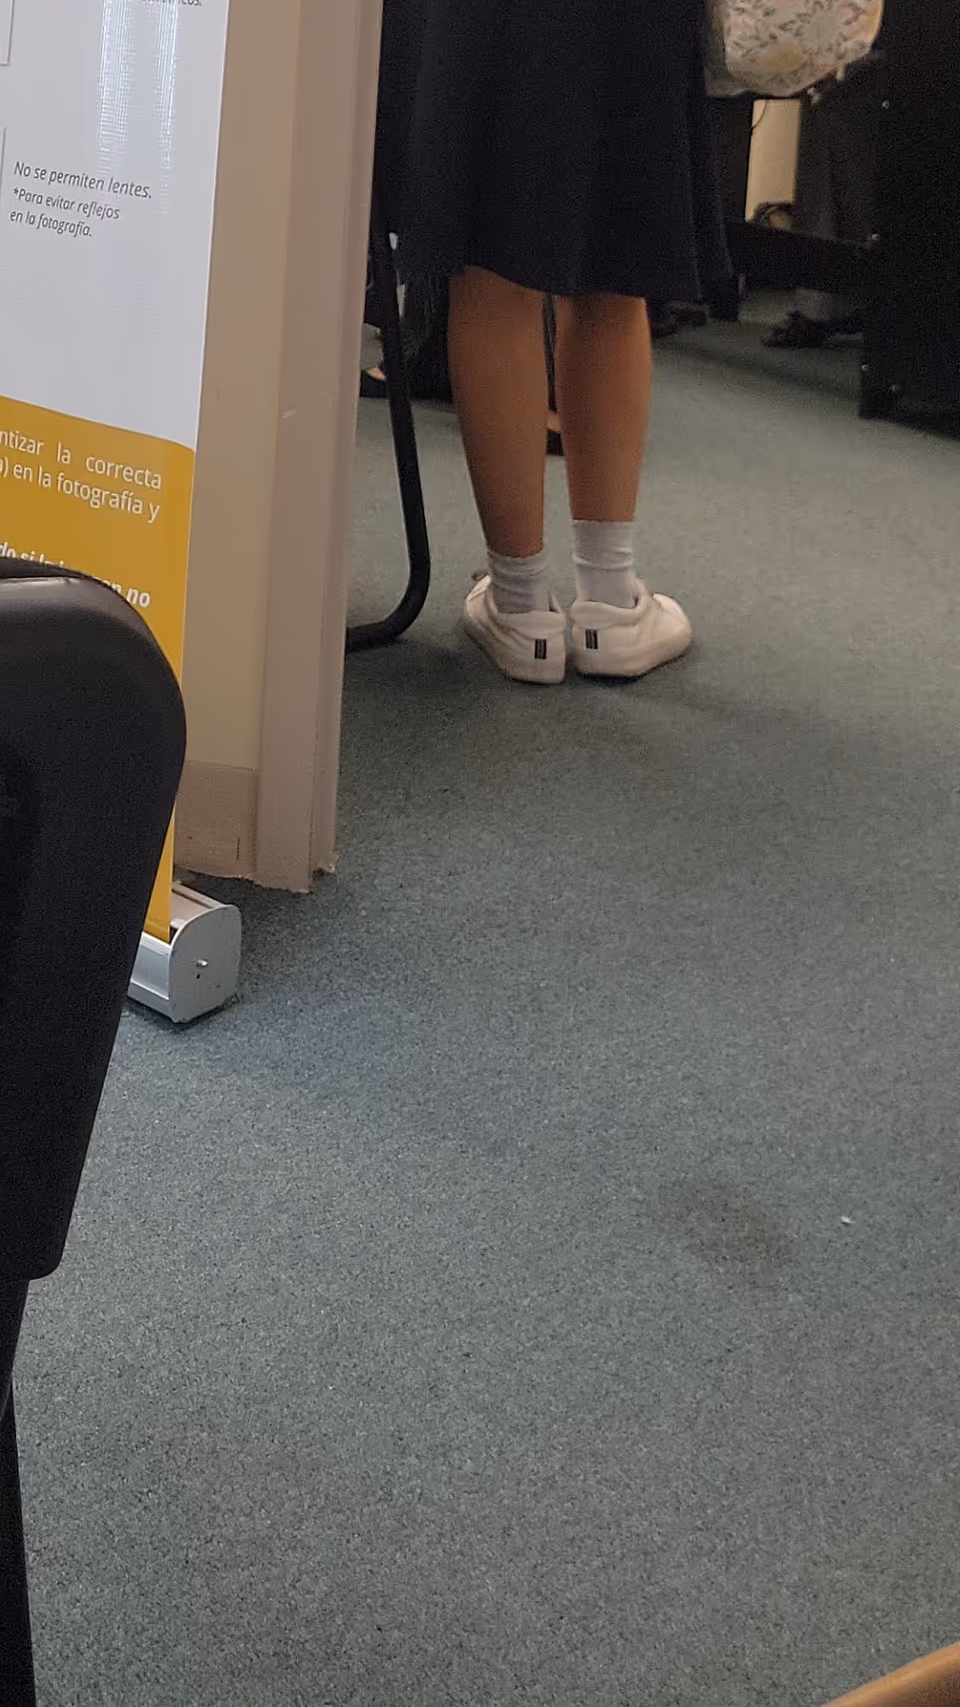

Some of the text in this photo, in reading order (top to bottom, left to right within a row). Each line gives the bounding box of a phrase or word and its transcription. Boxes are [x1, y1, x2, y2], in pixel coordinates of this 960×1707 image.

[13, 161, 152, 199] No se permiten lentes.
[46, 195, 76, 211] evitar
[77, 200, 121, 221] reflejos
[56, 442, 71, 464] la
[85, 456, 162, 490] correcta
[13, 463, 33, 482] en
[37, 466, 52, 488] la
[56, 472, 143, 515] fotografía
[147, 502, 161, 523] y
[126, 586, 151, 608] no
